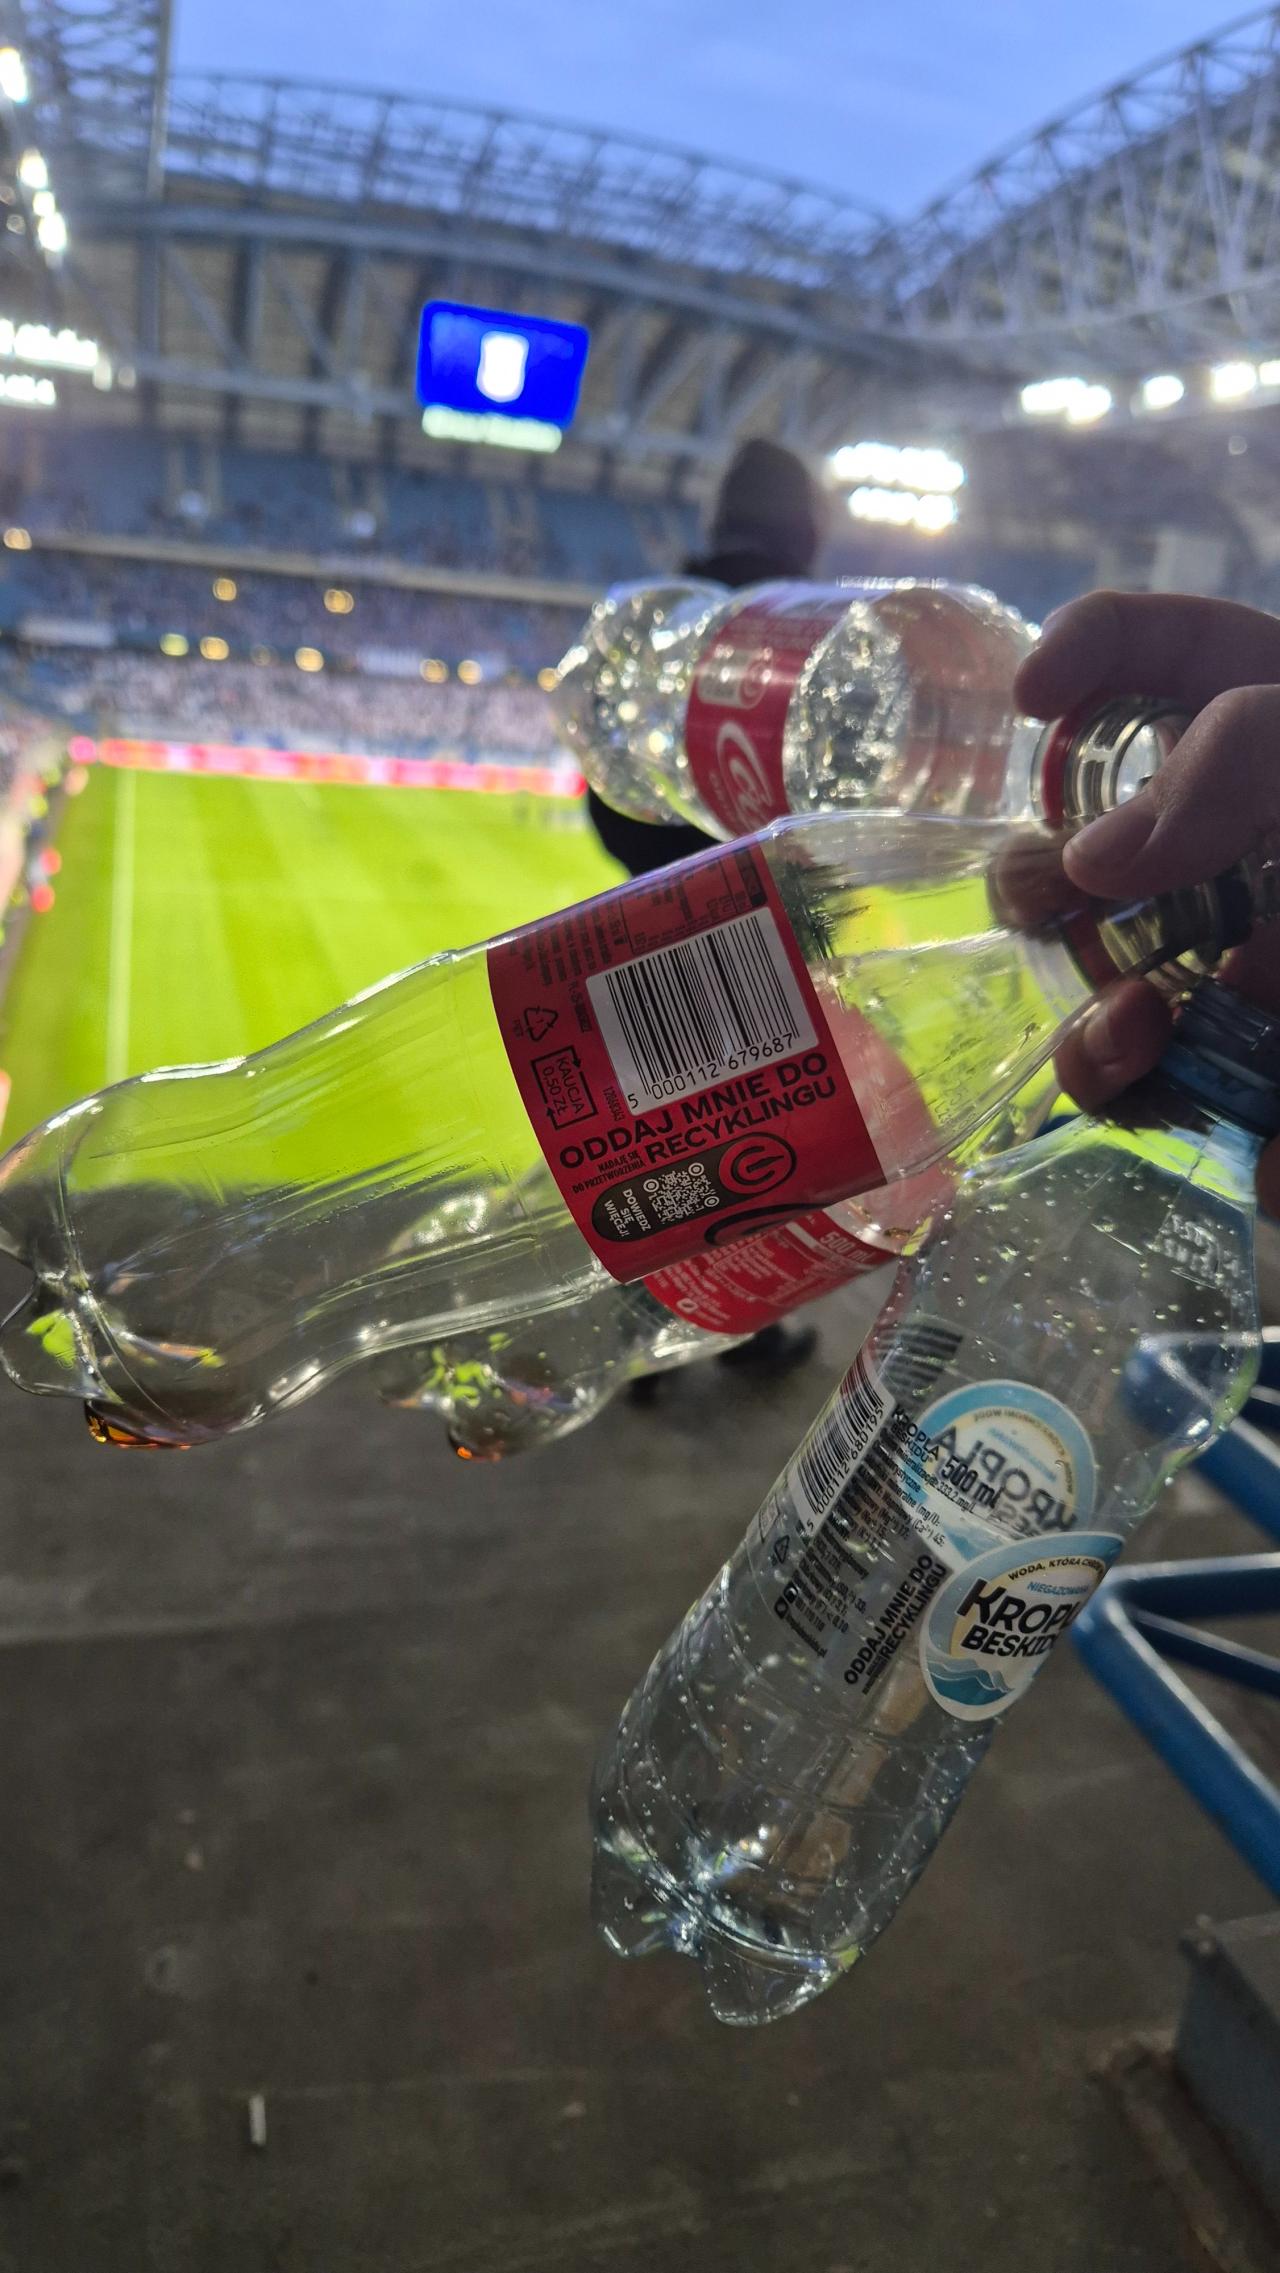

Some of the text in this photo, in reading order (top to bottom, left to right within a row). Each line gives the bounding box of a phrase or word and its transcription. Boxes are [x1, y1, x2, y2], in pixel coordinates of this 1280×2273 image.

[542, 1066, 567, 1115] 0,50 ZŁ
[557, 1057, 585, 1114] KAUCJA
[627, 1032, 793, 1109] 5 000112 679687
[560, 1052, 828, 1168] ODDAJ MNIE DO
[645, 1076, 837, 1163] RECYKLINGU
[572, 1159, 646, 1194] DO PRZETWORZENIA
[603, 1199, 630, 1237] WIĘCEJ!
[619, 1208, 635, 1225] SIĘ
[622, 1188, 652, 1232] DOWIEDZ
[820, 1231, 856, 1253] 500
[806, 1519, 814, 1533] 5
[817, 1460, 850, 1514] 000112
[851, 1406, 884, 1461] 680195
[891, 1405, 940, 1461] KROPLA
[940, 1454, 979, 1492] 500
[973, 1481, 1002, 1509] ml
[1008, 1562, 1046, 1581] WODA,
[1049, 1557, 1081, 1568] KTÓRA
[844, 1627, 886, 1685] ODDAJ
[879, 1580, 916, 1628] MNIE
[908, 1554, 933, 1584] DO
[880, 1563, 947, 1660] RECYKLINGU
